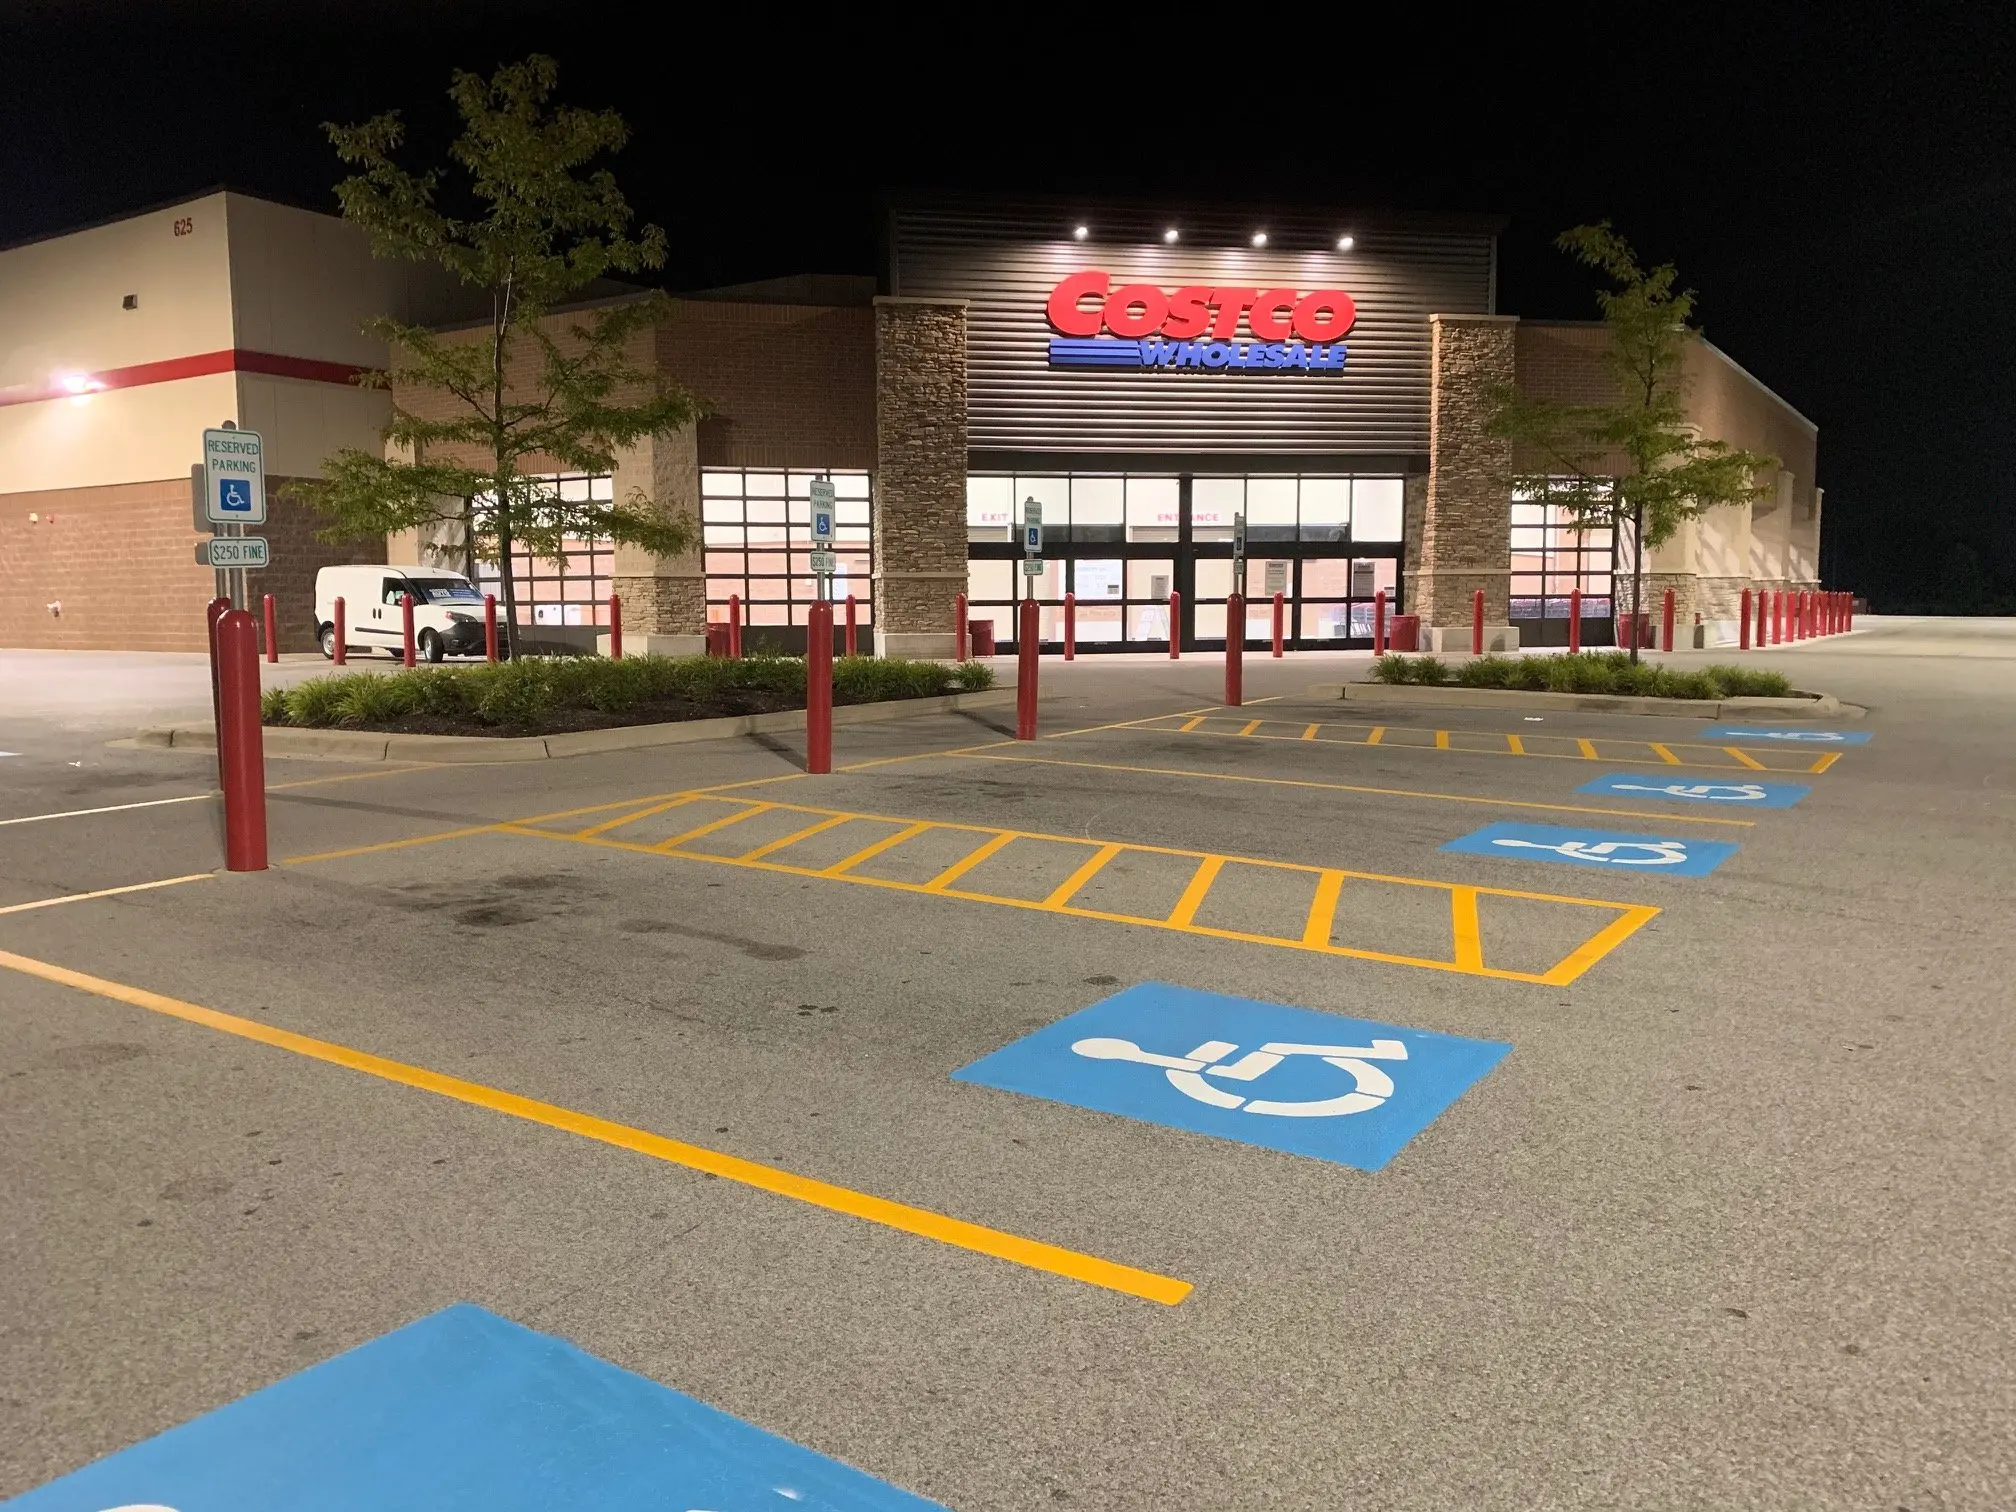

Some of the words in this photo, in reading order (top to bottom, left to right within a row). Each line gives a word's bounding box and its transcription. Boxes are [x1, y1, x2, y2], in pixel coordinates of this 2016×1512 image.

[173, 217, 193, 236] 625
[1046, 270, 1356, 342] COSTCO
[1138, 340, 1347, 372] WHOLESALE
[207, 440, 260, 456] RESERVED
[211, 459, 257, 474] PARKING
[981, 512, 1008, 522] EXIT
[1157, 512, 1220, 522] ENTANCE
[213, 544, 240, 561] $250
[243, 543, 264, 560] FINE
